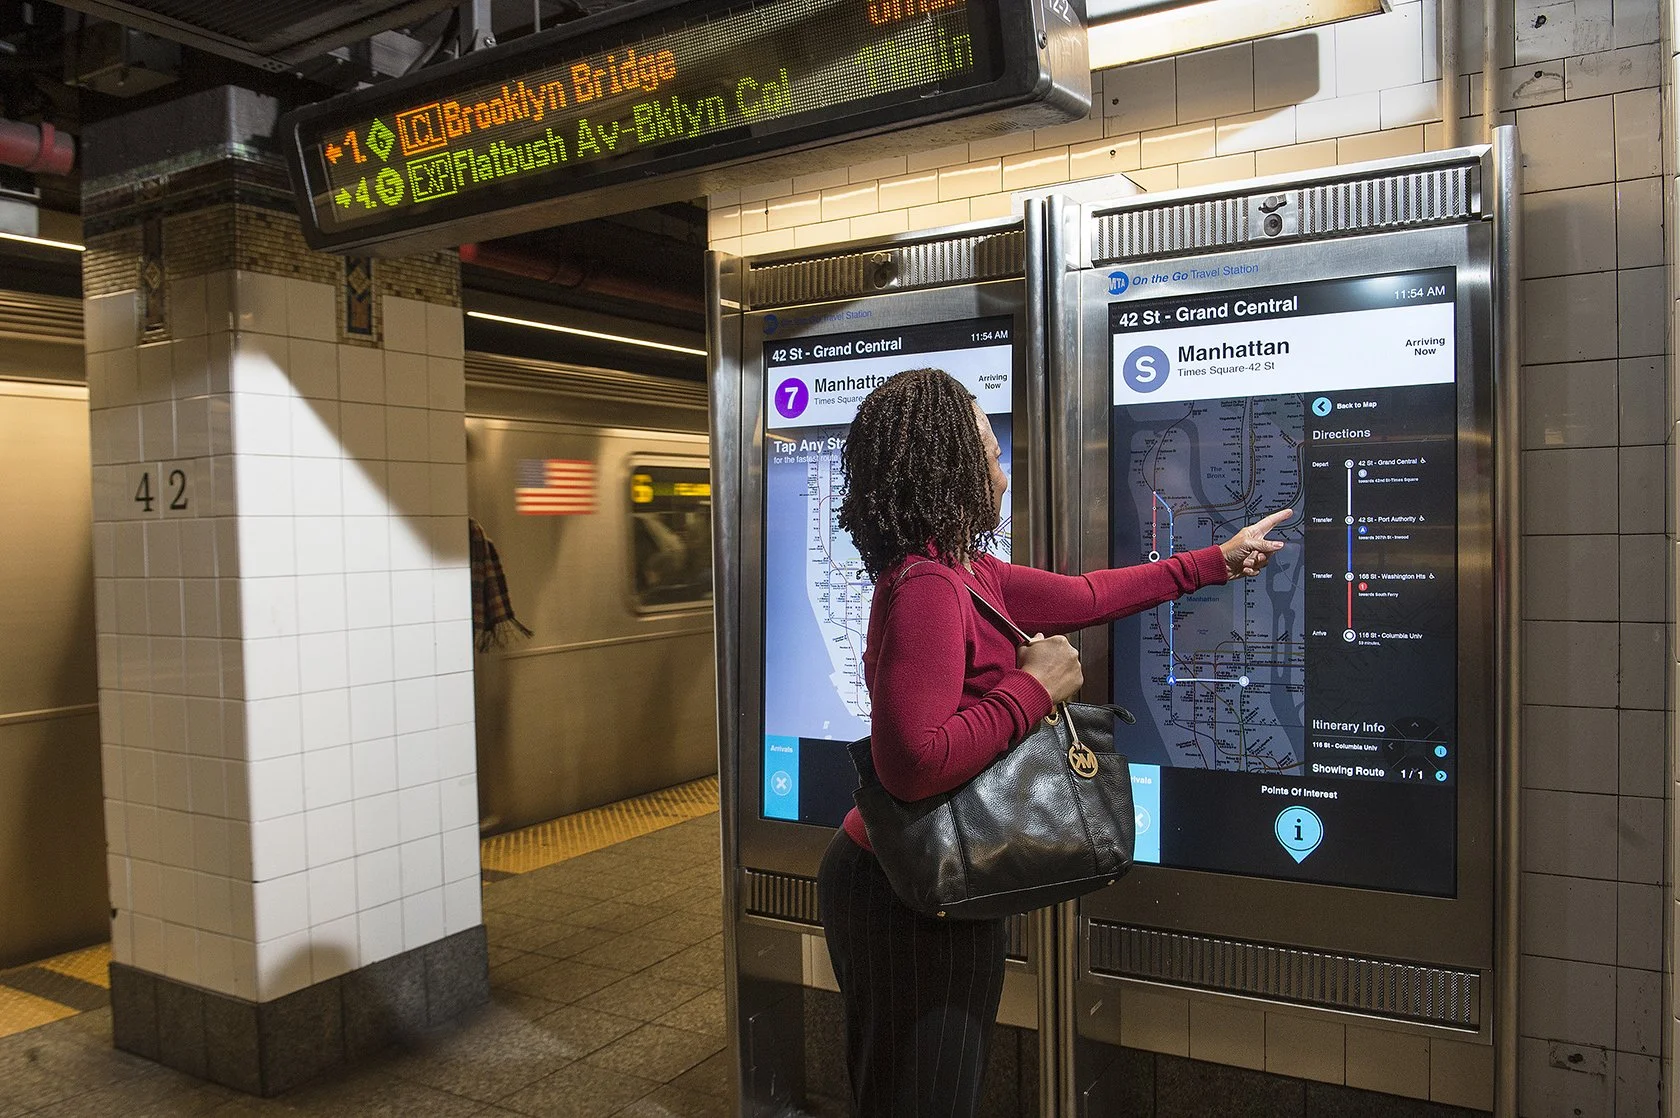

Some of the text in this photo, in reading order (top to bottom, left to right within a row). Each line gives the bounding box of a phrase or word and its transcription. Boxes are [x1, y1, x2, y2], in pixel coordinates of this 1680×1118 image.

[400, 112, 442, 149] LCL
[443, 81, 567, 138] Brooklyn
[570, 48, 678, 103] Bridge
[412, 160, 449, 195] EXP
[452, 127, 568, 187] Flatbush
[576, 89, 728, 158] Av-Bklyn
[1107, 263, 1259, 292] MTA On the Go Travel Station
[1394, 284, 1447, 301] 11:54 AM
[846, 310, 872, 320] Station
[1119, 312, 1138, 328] 42
[1143, 309, 1161, 325] St
[1176, 302, 1229, 322] Grand
[1234, 295, 1299, 316] Central
[970, 329, 1009, 342] 11:54 AM
[772, 349, 787, 362] 42
[789, 347, 803, 361] St
[813, 342, 852, 358] Grand
[855, 336, 902, 354] Central
[1405, 336, 1446, 349] Arriving
[1177, 338, 1290, 363] Manhattan
[1414, 346, 1437, 356] Now
[1134, 356, 1157, 383] S
[1177, 360, 1275, 377] Times Square-42 St
[978, 373, 1008, 384] Arriving
[984, 382, 1001, 390] Now
[784, 387, 799, 410] 7
[814, 397, 836, 406] Times
[1336, 402, 1354, 410] Back
[1362, 401, 1377, 410] Map
[1312, 428, 1371, 440] Directions
[773, 440, 797, 455] Tap
[799, 439, 825, 454] Any
[773, 456, 783, 464] for
[784, 456, 796, 464] the
[796, 455, 821, 464] fastest
[1312, 461, 1329, 469] Depart
[1391, 515, 1417, 523] Authority
[1381, 573, 1415, 581] Washington
[1409, 632, 1423, 640] Univ
[1312, 719, 1386, 734] Itinerary Info
[1334, 742, 1363, 751] Columbia
[1363, 744, 1378, 752] Univ
[1312, 763, 1385, 778] Showing Route
[1400, 769, 1406, 779] 1
[1418, 770, 1423, 780] 1
[1130, 775, 1153, 785] rivals
[1260, 785, 1338, 799] Points Of Interest
